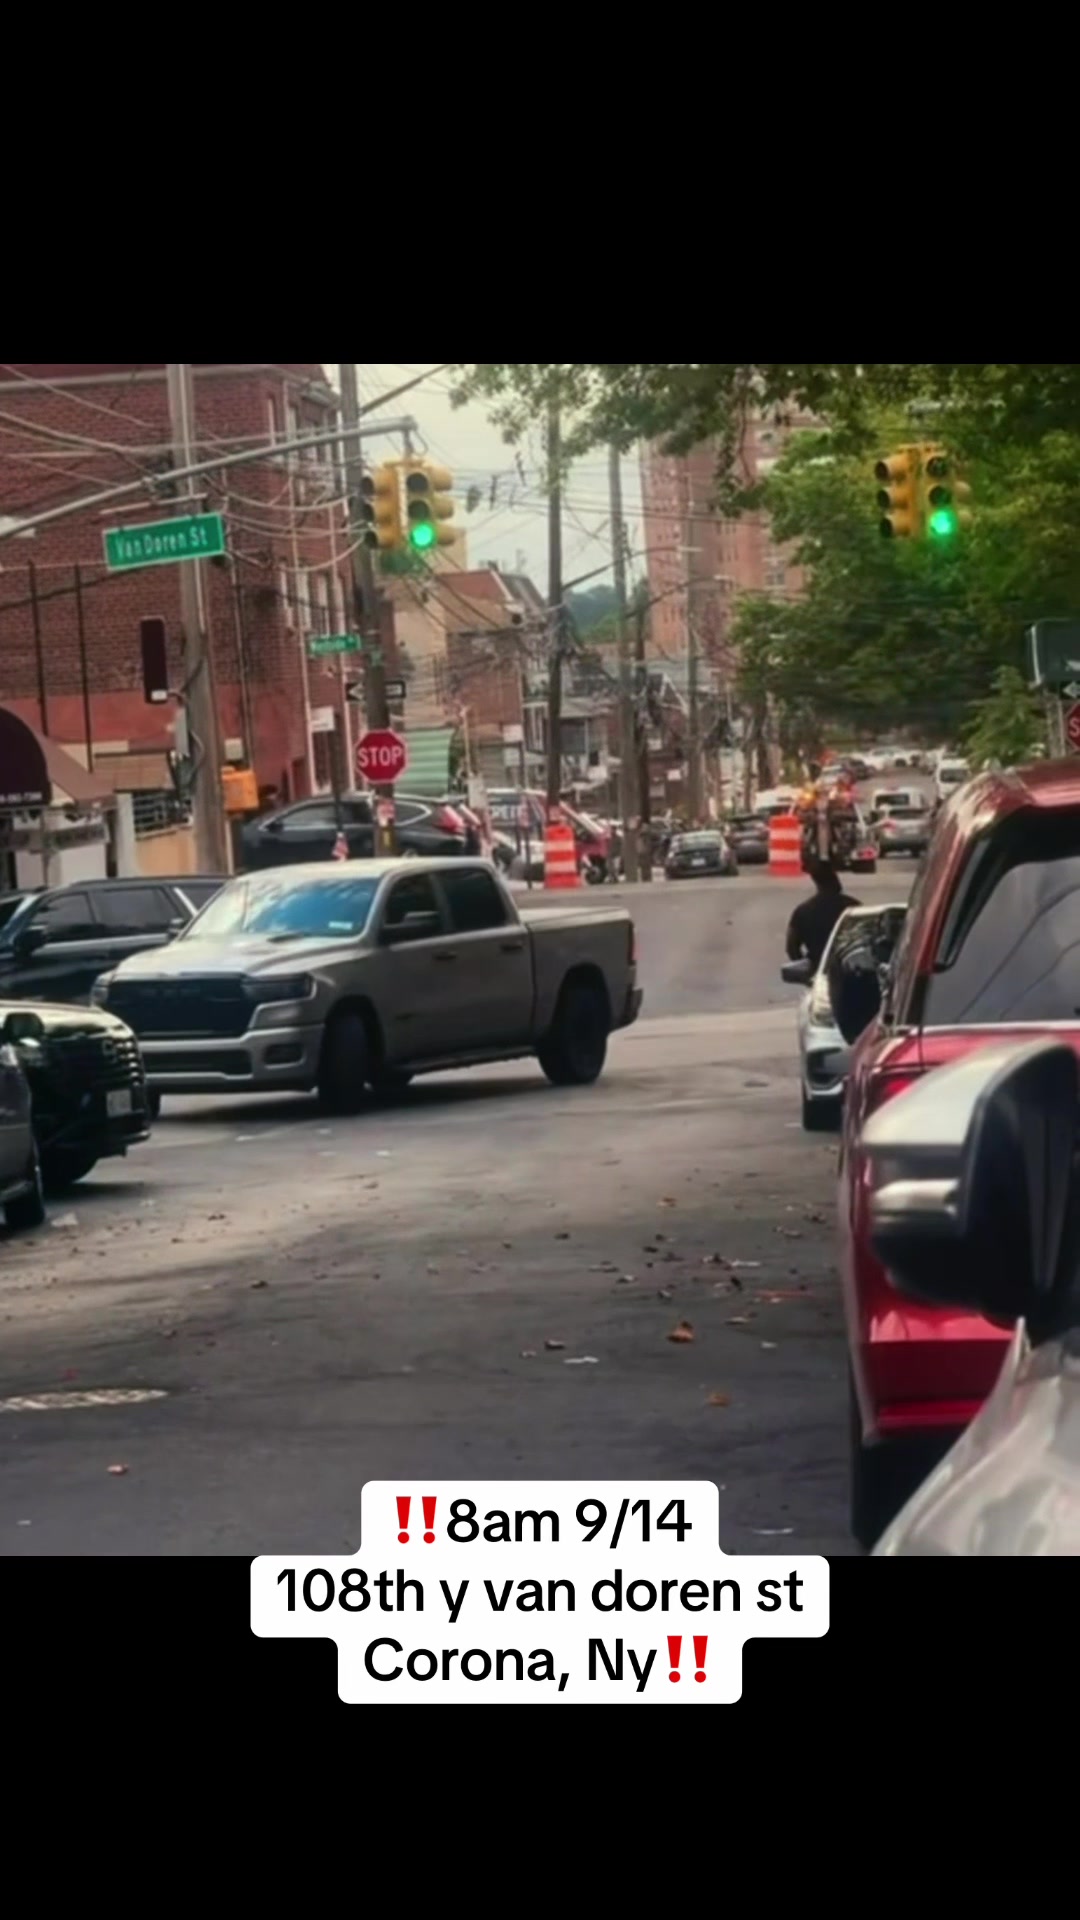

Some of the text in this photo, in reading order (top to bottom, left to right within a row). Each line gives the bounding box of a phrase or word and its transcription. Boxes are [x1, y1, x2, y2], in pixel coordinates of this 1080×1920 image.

[114, 525, 208, 560] Van Doren St
[357, 744, 403, 768] STOP
